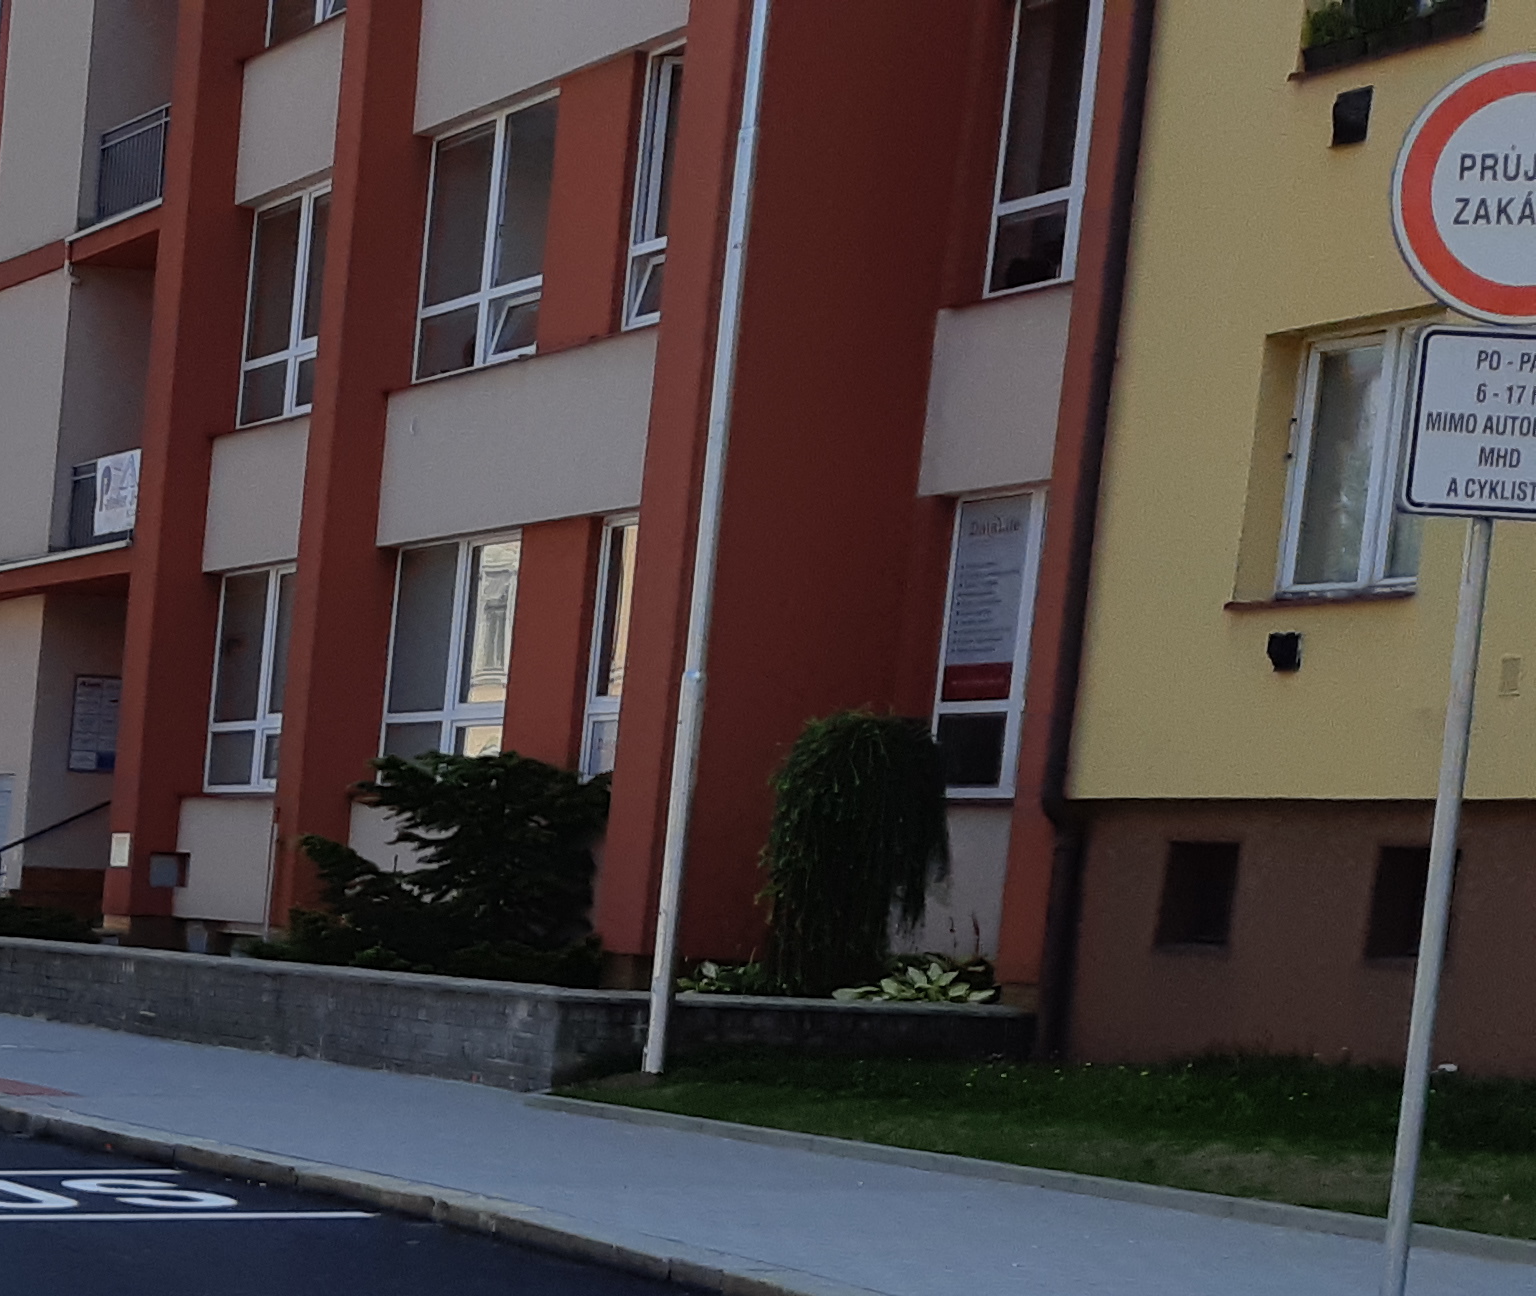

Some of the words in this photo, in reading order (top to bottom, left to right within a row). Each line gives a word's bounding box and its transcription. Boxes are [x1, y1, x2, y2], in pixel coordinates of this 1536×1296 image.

[1452, 191, 1536, 226] ZAKÁ
[1477, 350, 1501, 371] PO
[1476, 383, 1488, 403] 6
[1506, 384, 1527, 405] 17
[1426, 411, 1477, 434] MIMO
[1482, 415, 1536, 438] AUTO
[1479, 446, 1522, 468] MHD
[1446, 477, 1459, 498] A
